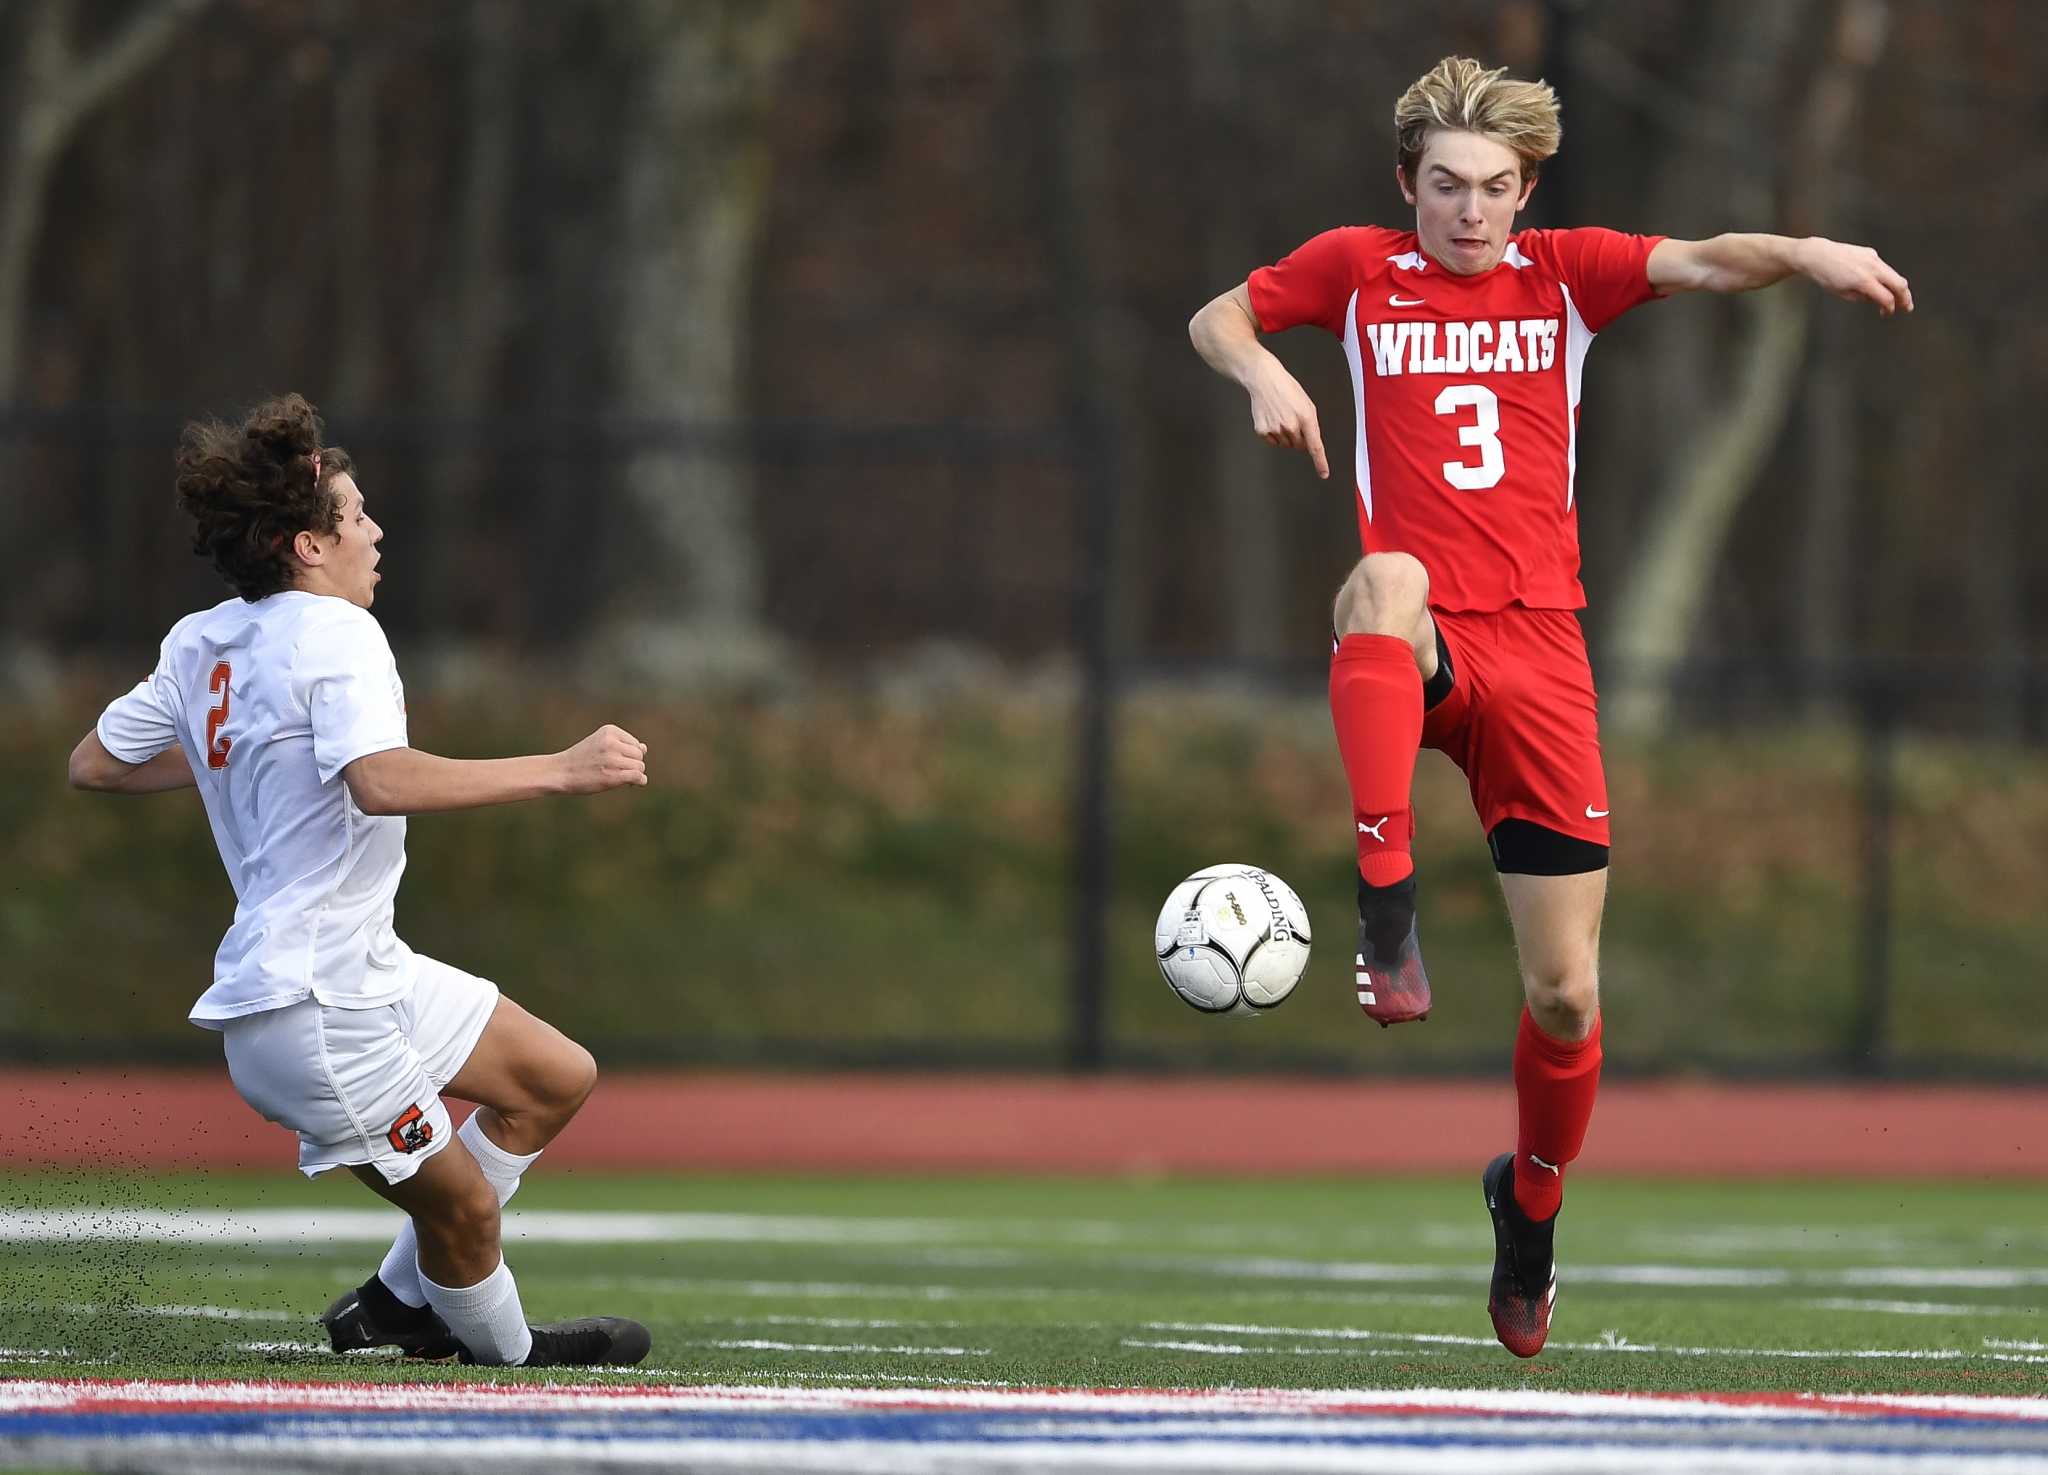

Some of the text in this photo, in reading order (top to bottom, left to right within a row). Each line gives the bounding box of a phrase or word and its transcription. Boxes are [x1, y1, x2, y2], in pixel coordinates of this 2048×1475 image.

[1366, 319, 1559, 376] WILDCATS
[1434, 384, 1506, 490] 3
[206, 660, 232, 770] 2
[1241, 869, 1290, 942] SPALDING
